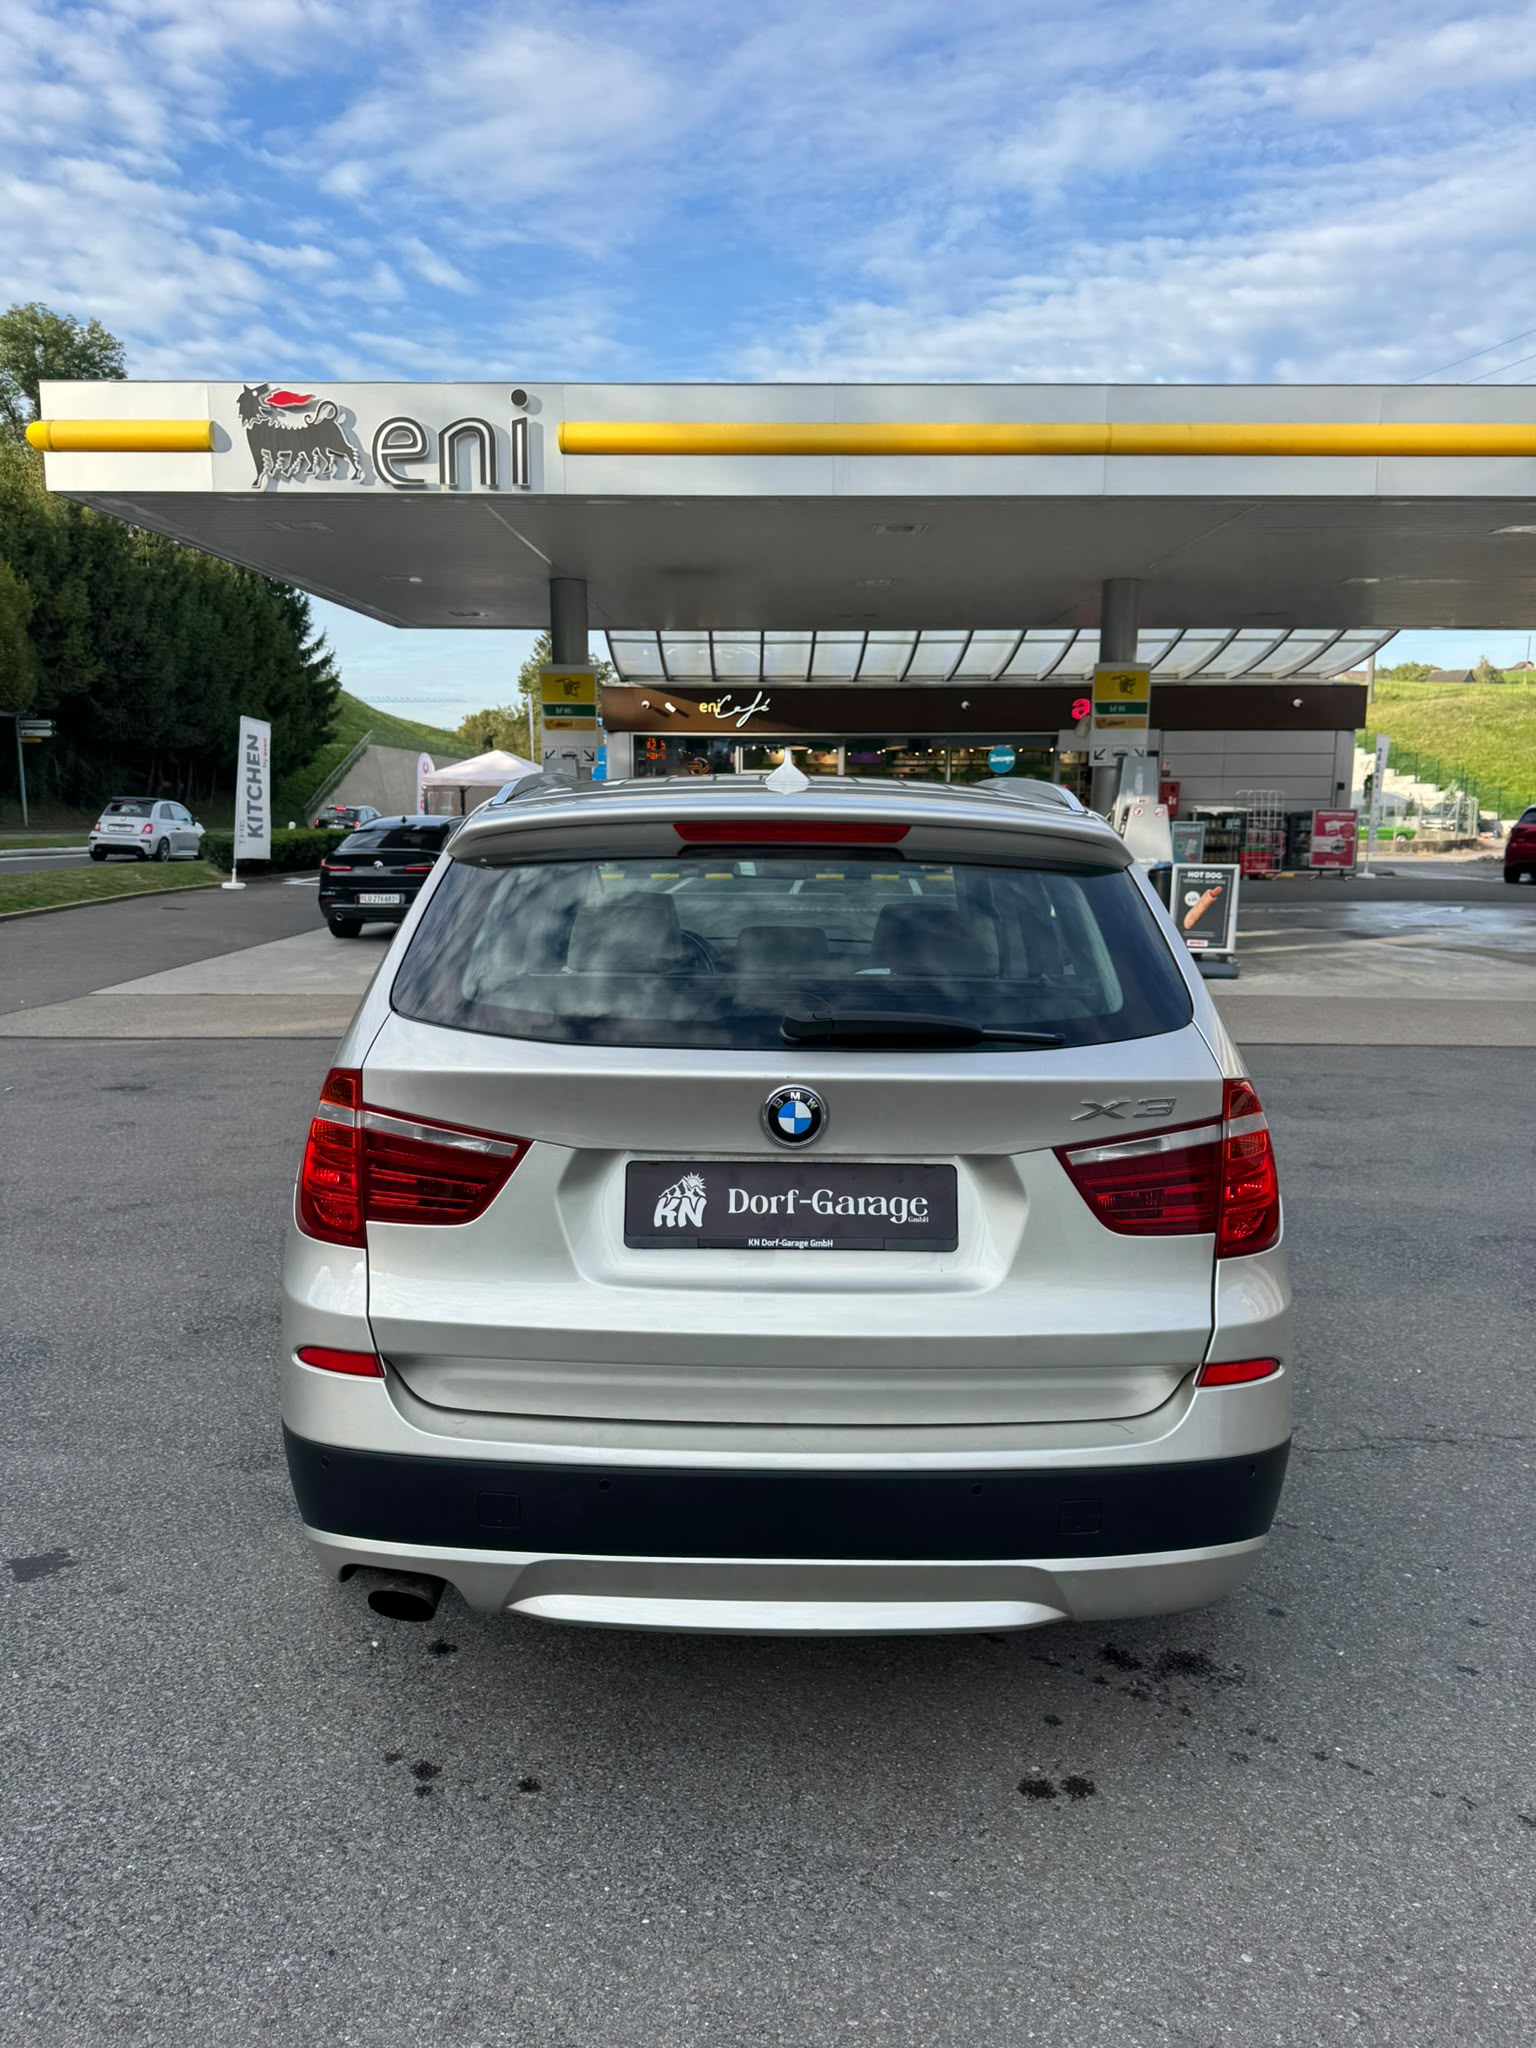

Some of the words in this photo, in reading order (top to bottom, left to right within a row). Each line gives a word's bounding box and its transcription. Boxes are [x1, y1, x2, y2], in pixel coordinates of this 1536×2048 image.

[372, 388, 530, 486] eni
[699, 699, 721, 713] eni
[246, 733, 264, 839] KITCHEN
[238, 819, 246, 846] THE
[1205, 871, 1223, 879] DOG
[773, 1091, 819, 1110] BMW
[1070, 1096, 1177, 1121] X3
[653, 1197, 707, 1227] KN
[727, 1188, 929, 1224] Dorf-Garage
[907, 1215, 929, 1223] GmbH
[748, 1238, 760, 1247] KN
[761, 1238, 808, 1249] Dorf-Garage
[810, 1239, 834, 1248] GmbH
